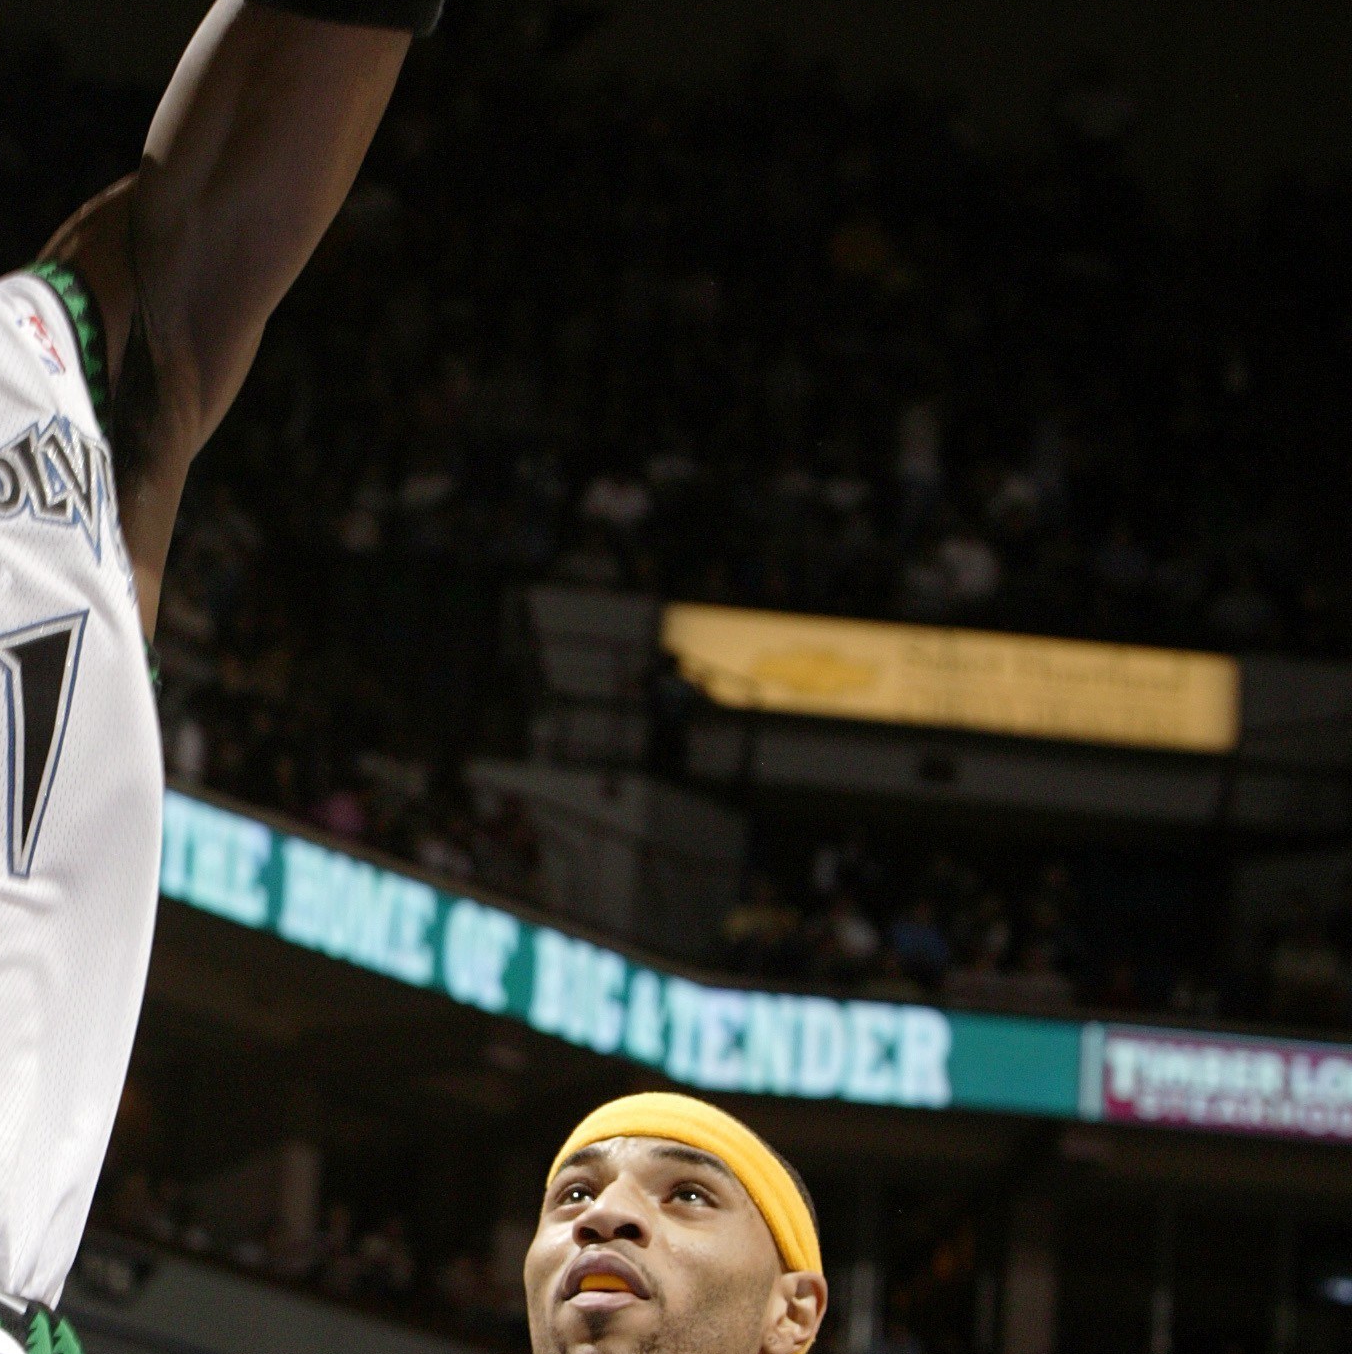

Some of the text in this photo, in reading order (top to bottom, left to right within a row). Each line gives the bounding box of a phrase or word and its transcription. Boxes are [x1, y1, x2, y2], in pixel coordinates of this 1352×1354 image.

[277, 836, 440, 989] HOME
[445, 896, 524, 1015] OF
[528, 926, 625, 1056] BIG
[664, 975, 952, 1109] TENDER
